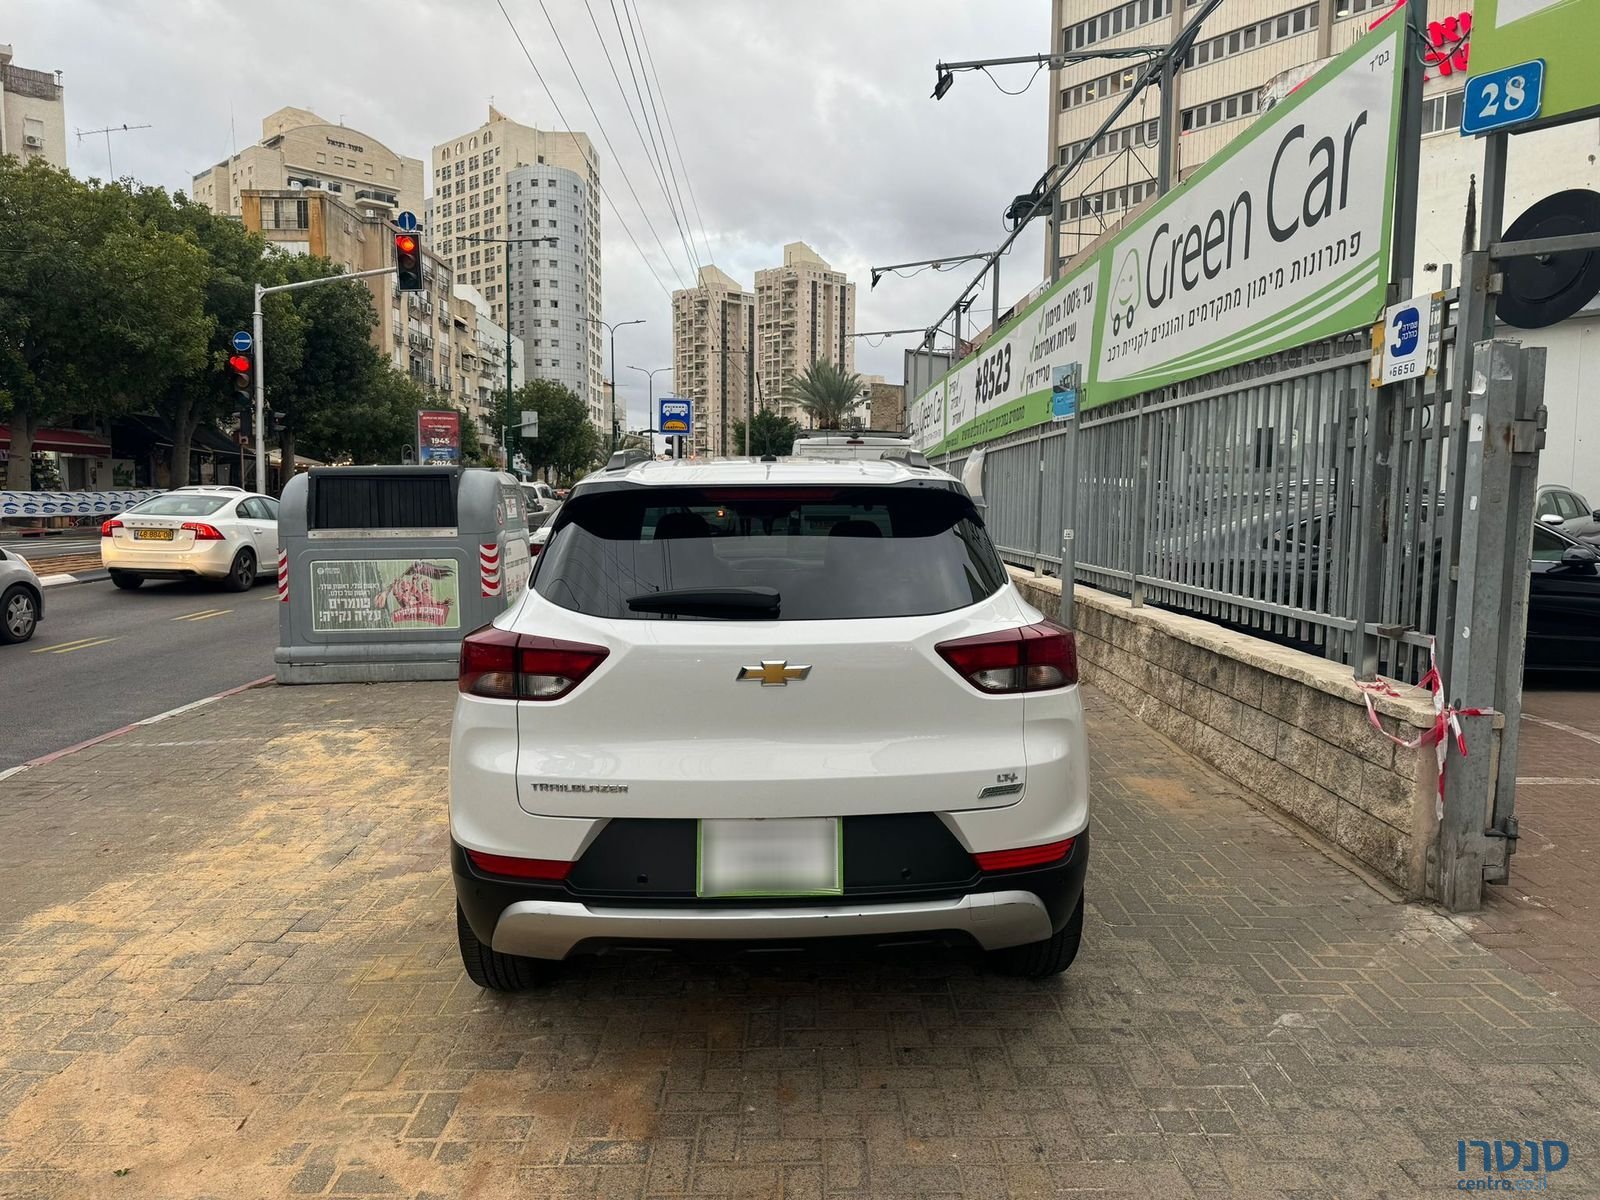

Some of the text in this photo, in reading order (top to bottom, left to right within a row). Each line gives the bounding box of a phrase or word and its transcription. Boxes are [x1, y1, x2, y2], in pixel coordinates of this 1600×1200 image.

[1478, 75, 1526, 118] 28
[1146, 110, 1368, 309] Green Car
[1063, 287, 1081, 320] 100%
[1083, 281, 1094, 304] עד
[1107, 231, 1362, 363] פתרונות מימון מתקדמים והוגנים לקניית רכב
[1044, 303, 1061, 335] מימון
[319, 608, 381, 623] עליה נקייה!
[530, 783, 629, 794] TRAILBLAZER
